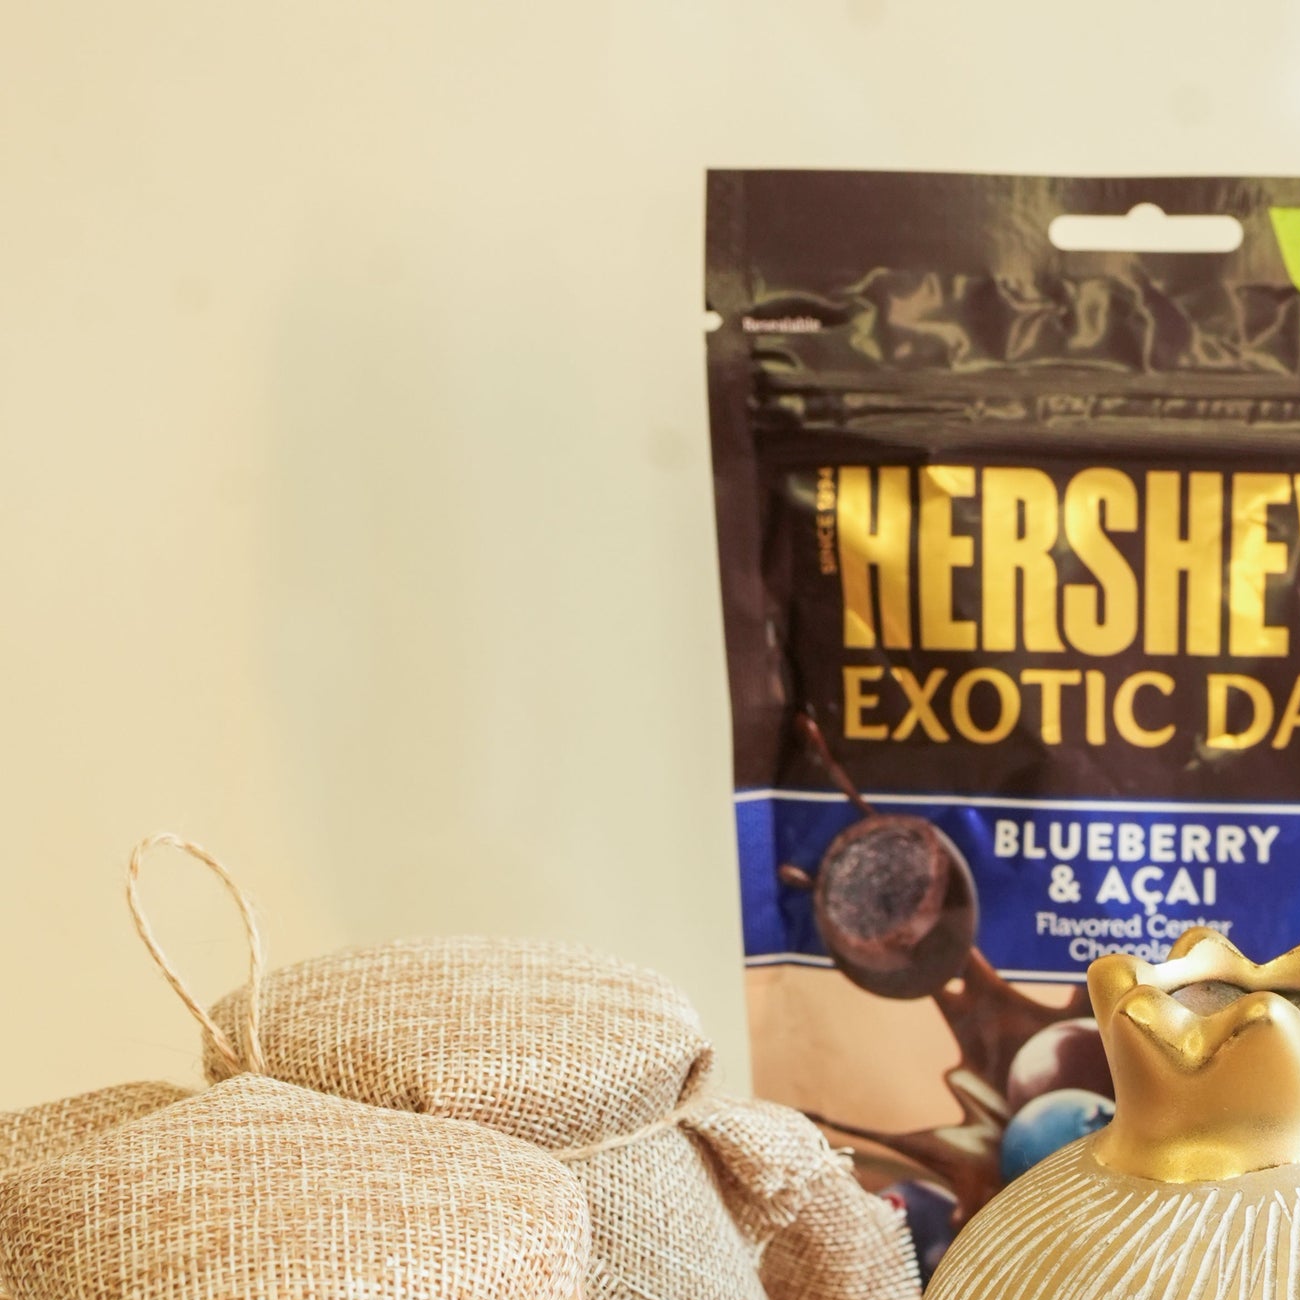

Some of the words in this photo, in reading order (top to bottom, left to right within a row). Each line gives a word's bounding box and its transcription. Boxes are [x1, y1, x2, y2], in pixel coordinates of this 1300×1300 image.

[843, 665, 1176, 748] EXOTIC
[994, 819, 1280, 864] BLUEBERRY
[1048, 864, 1081, 903] &
[1095, 865, 1217, 914] AÇAI
[1036, 912, 1142, 938] Flavored
[1068, 937, 1173, 963] Chocola
